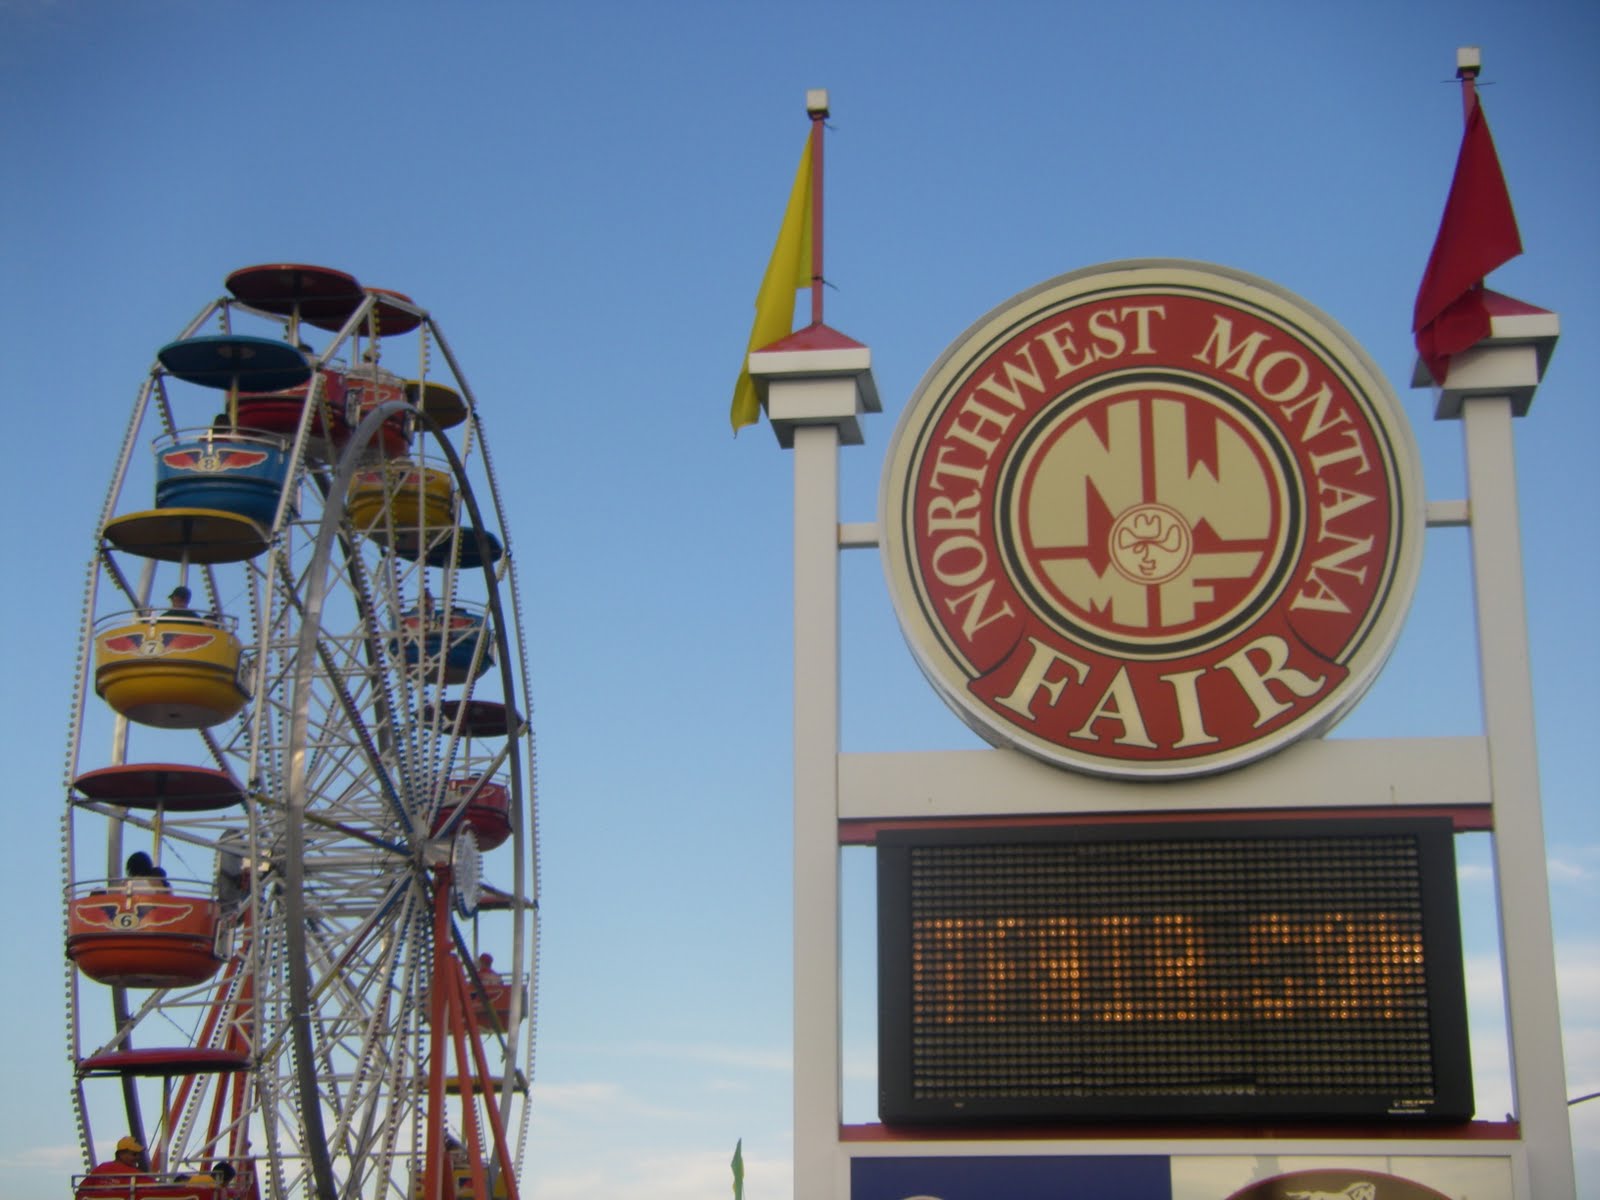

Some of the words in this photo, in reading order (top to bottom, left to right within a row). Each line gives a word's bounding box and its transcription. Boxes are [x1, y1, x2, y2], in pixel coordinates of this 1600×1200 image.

[926, 305, 1166, 642] NORTHWEST
[1193, 315, 1377, 615] MONTANA
[147, 642, 158, 653] 7
[995, 633, 1327, 750] FAIR
[120, 914, 132, 927] 6
